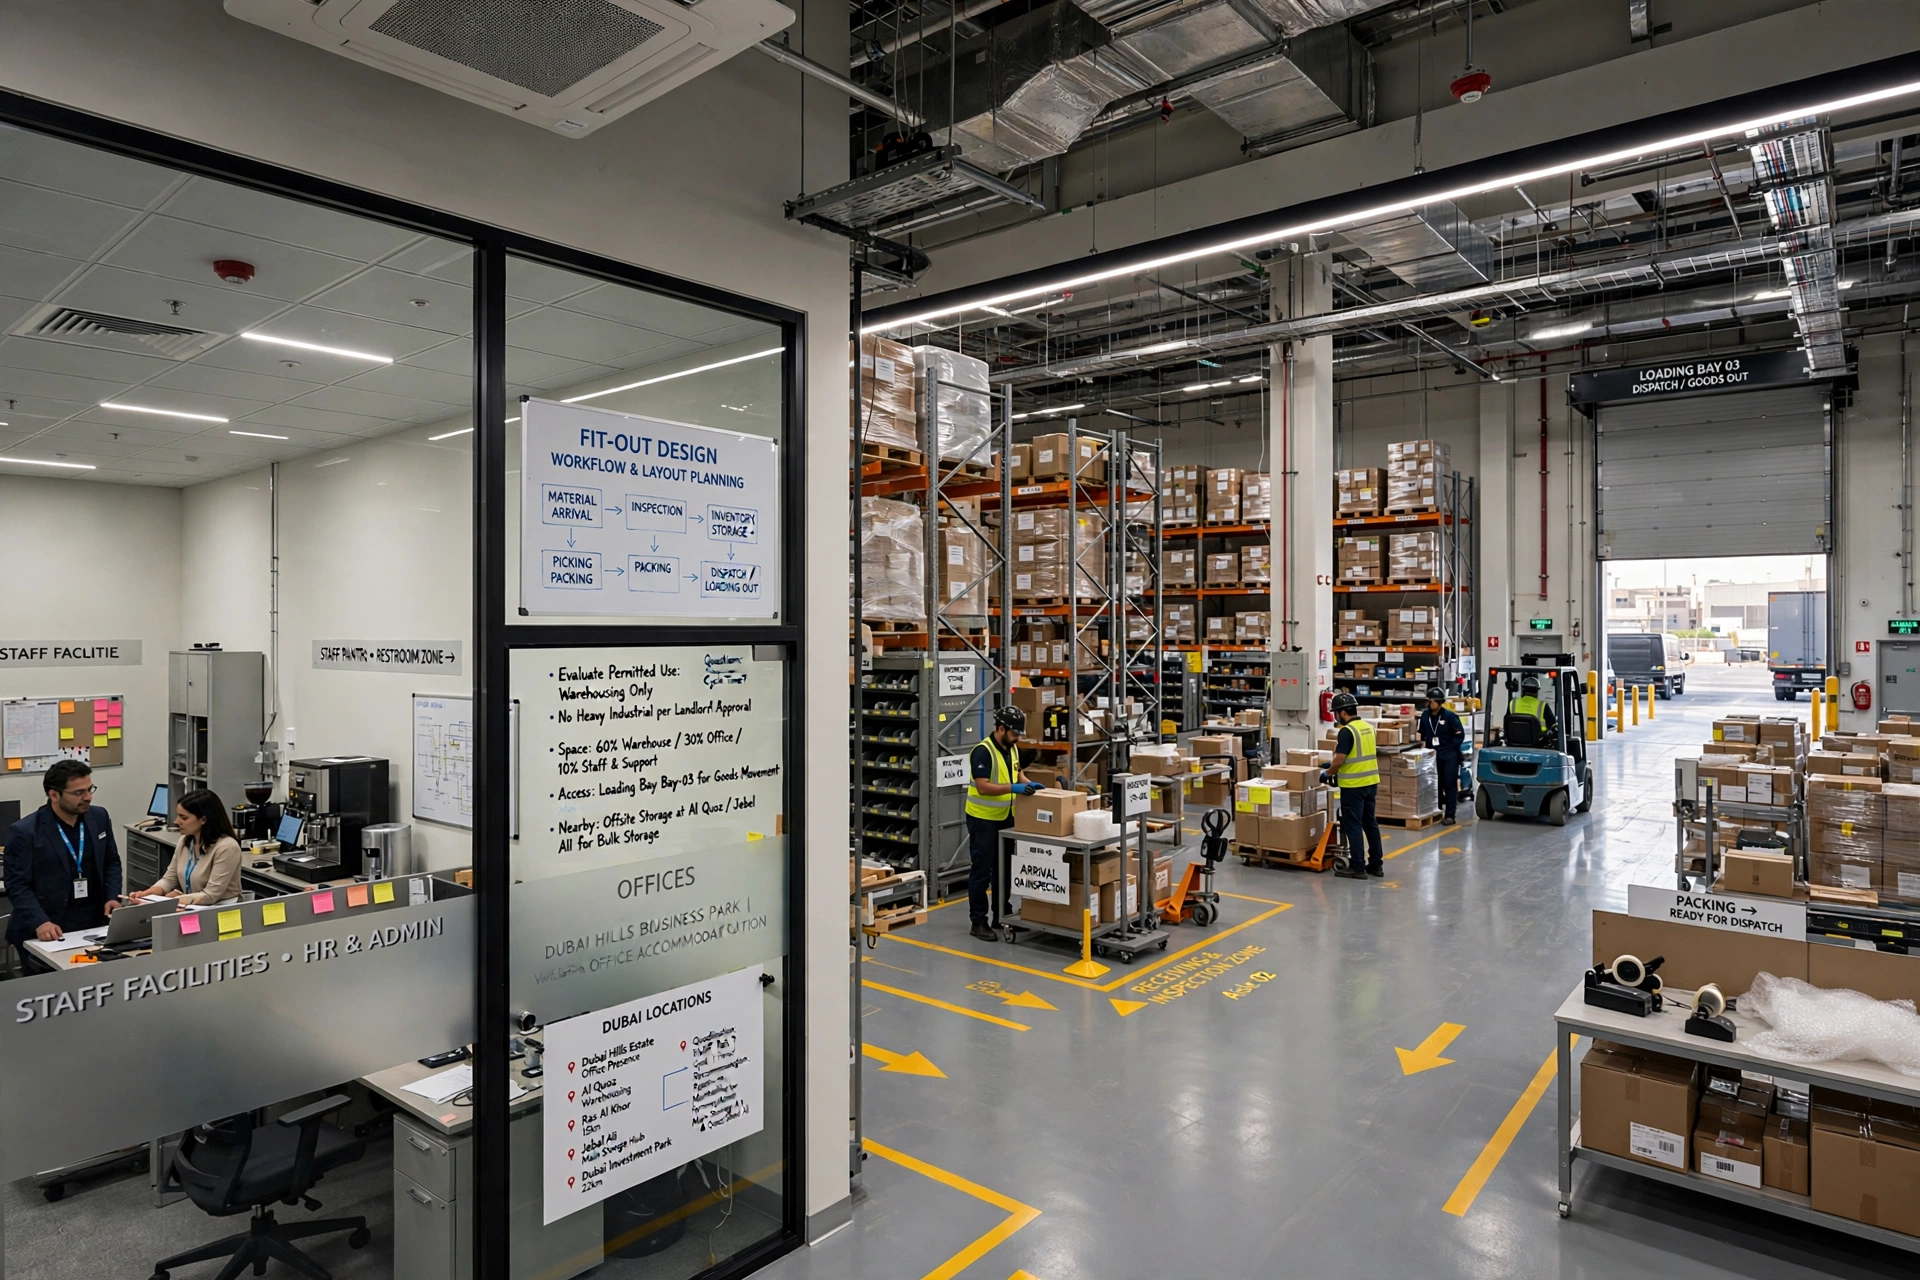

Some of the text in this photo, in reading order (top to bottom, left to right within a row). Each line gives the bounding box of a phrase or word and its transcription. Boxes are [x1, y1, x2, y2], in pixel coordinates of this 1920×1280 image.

[1640, 359, 1740, 381] LOADING BAY 03
[1632, 372, 1749, 394] DISPATCH / GOODS OUT
[580, 428, 718, 464] FIT-OUT DESIGN
[550, 452, 744, 489] WORKFLOW & LAYOUT PLANNING
[548, 490, 598, 506] MATERIAL
[631, 501, 683, 516] INSPECTION
[552, 507, 593, 521] ARRIVAL
[552, 556, 593, 569] PICKING
[634, 561, 672, 574] PACKING
[550, 572, 593, 584] PACKING
[742, 584, 759, 593] OUT
[0, 646, 120, 660] STAFF FACLITIE
[420, 649, 444, 664] ZONE
[558, 664, 680, 682] Evaluate Permitted Use:
[558, 682, 654, 702] Warehousing Only
[558, 709, 572, 724] No
[576, 708, 605, 726] Heavy
[610, 704, 654, 720] Industrial
[656, 708, 672, 721] per
[558, 727, 743, 761] Space: 60% Warehouse / 30% Office /
[558, 754, 658, 776] 10% Staff & Support
[558, 787, 595, 800] Access:
[599, 780, 636, 797] Loading
[639, 777, 658, 795] Bay
[697, 770, 711, 785] for
[558, 818, 600, 836] Nearby:
[603, 812, 636, 828] Offsite
[639, 809, 673, 824] Storage
[676, 806, 685, 818] at
[688, 802, 698, 816] Al
[725, 796, 732, 814] /
[733, 794, 756, 810] Jebel
[558, 829, 660, 854] All for Bulk Storage
[618, 866, 696, 900] OFFICES
[1020, 864, 1058, 880] ARRIVAL
[1676, 895, 1736, 914] PACKING
[545, 936, 590, 960] DUBAI
[596, 924, 634, 947] HILLS
[709, 898, 741, 920] PARK
[1670, 908, 1783, 934] READY FOR DISPATCH
[590, 948, 633, 972] OFFICE
[1223, 944, 1267, 965] ZONE
[16, 916, 444, 1024] STAFF FACILITIES HR & ADMIN
[602, 990, 712, 1034] DUBAI LOCATIONS
[582, 1050, 607, 1067] Dubai
[629, 1038, 655, 1052] Estate
[581, 1083, 592, 1097] Al
[582, 1114, 598, 1126] Ras
[600, 1106, 608, 1119] Al
[582, 1137, 672, 1181] Dubai Investment Park
